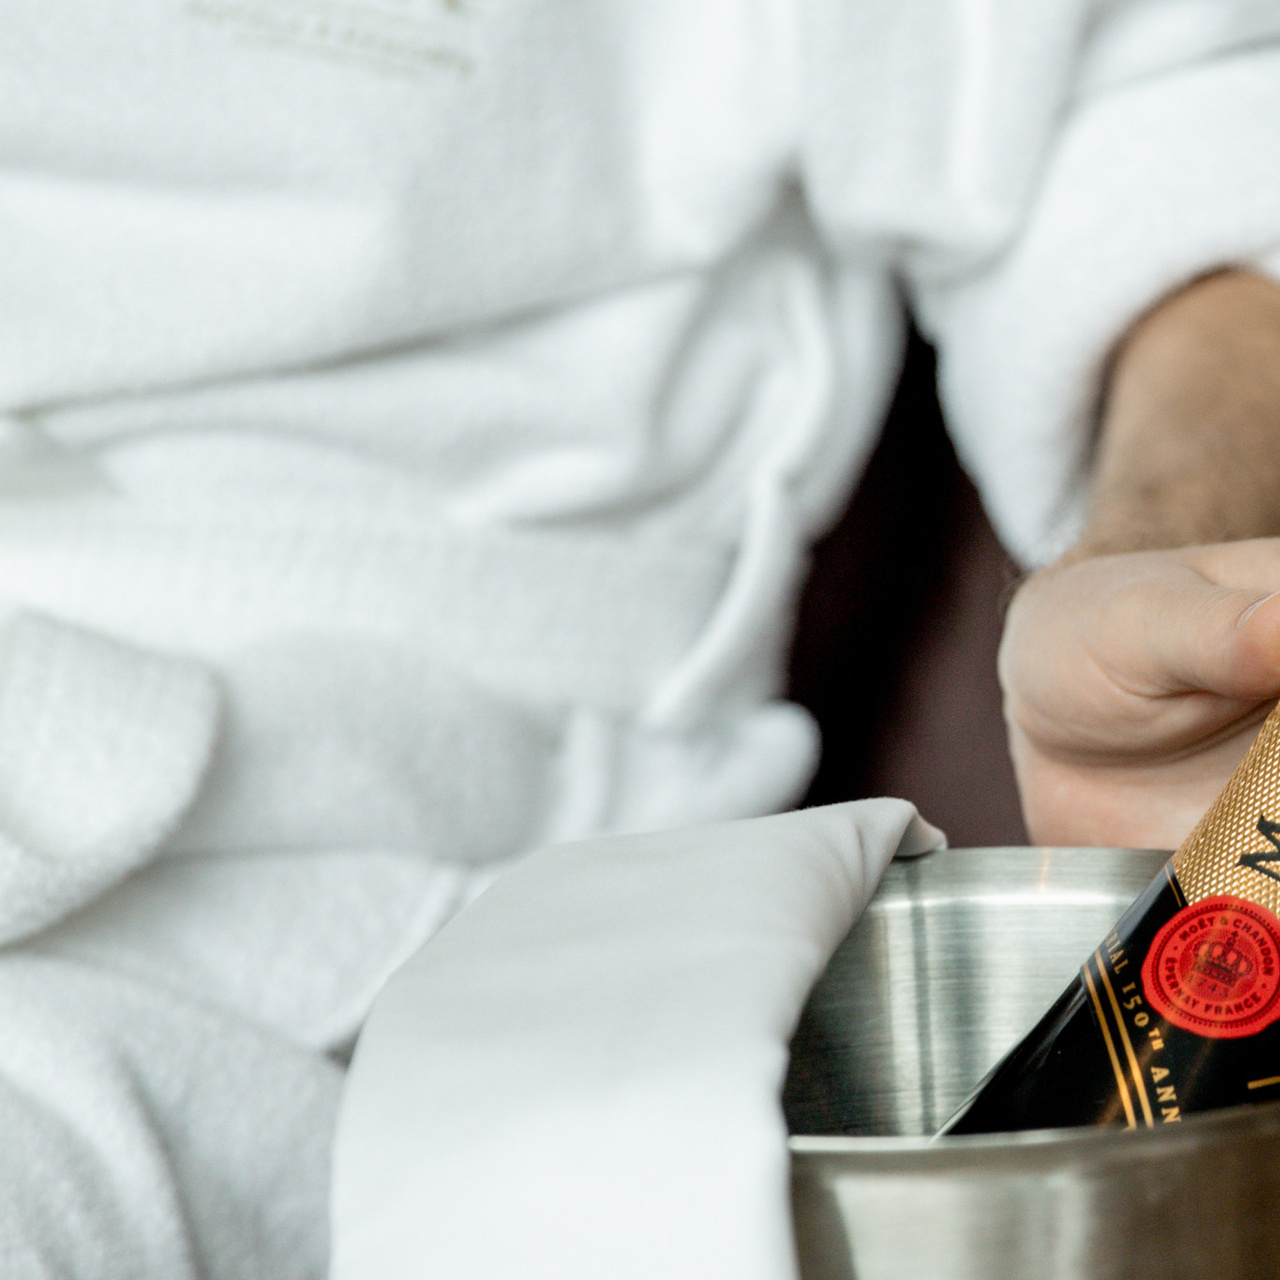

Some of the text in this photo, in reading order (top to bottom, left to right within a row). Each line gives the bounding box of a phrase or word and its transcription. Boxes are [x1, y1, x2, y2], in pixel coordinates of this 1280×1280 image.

[1105, 931, 1129, 975] RIAL
[1232, 918, 1275, 976] CHANDON
[1203, 991, 1262, 1015] FRANCE
